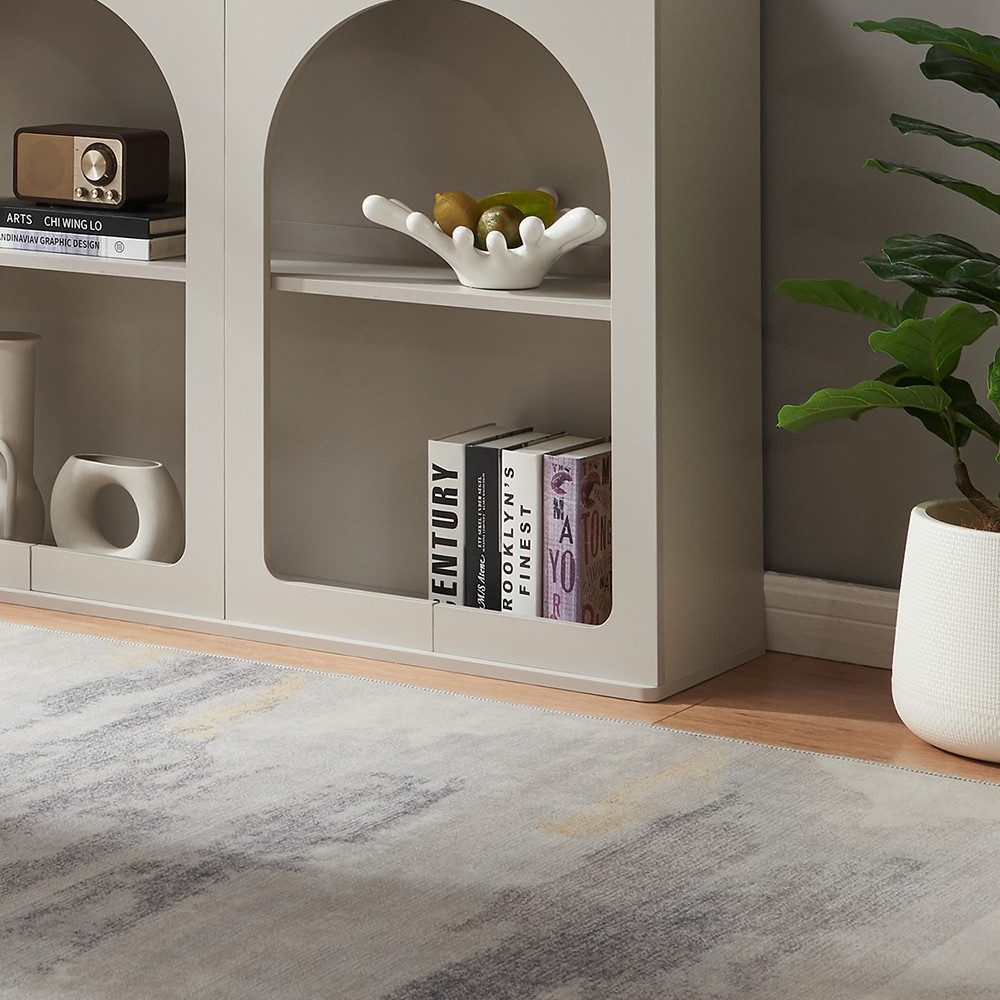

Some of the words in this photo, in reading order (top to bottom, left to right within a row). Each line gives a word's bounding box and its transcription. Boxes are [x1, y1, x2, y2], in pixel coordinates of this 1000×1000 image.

[6, 212, 33, 225] ARTS
[44, 216, 60, 227] CHI
[62, 218, 88, 230] WING
[89, 220, 103, 231] LO
[40, 236, 72, 248] GRAPHIC
[73, 239, 100, 250] DESIGN
[519, 505, 532, 596] FINEST
